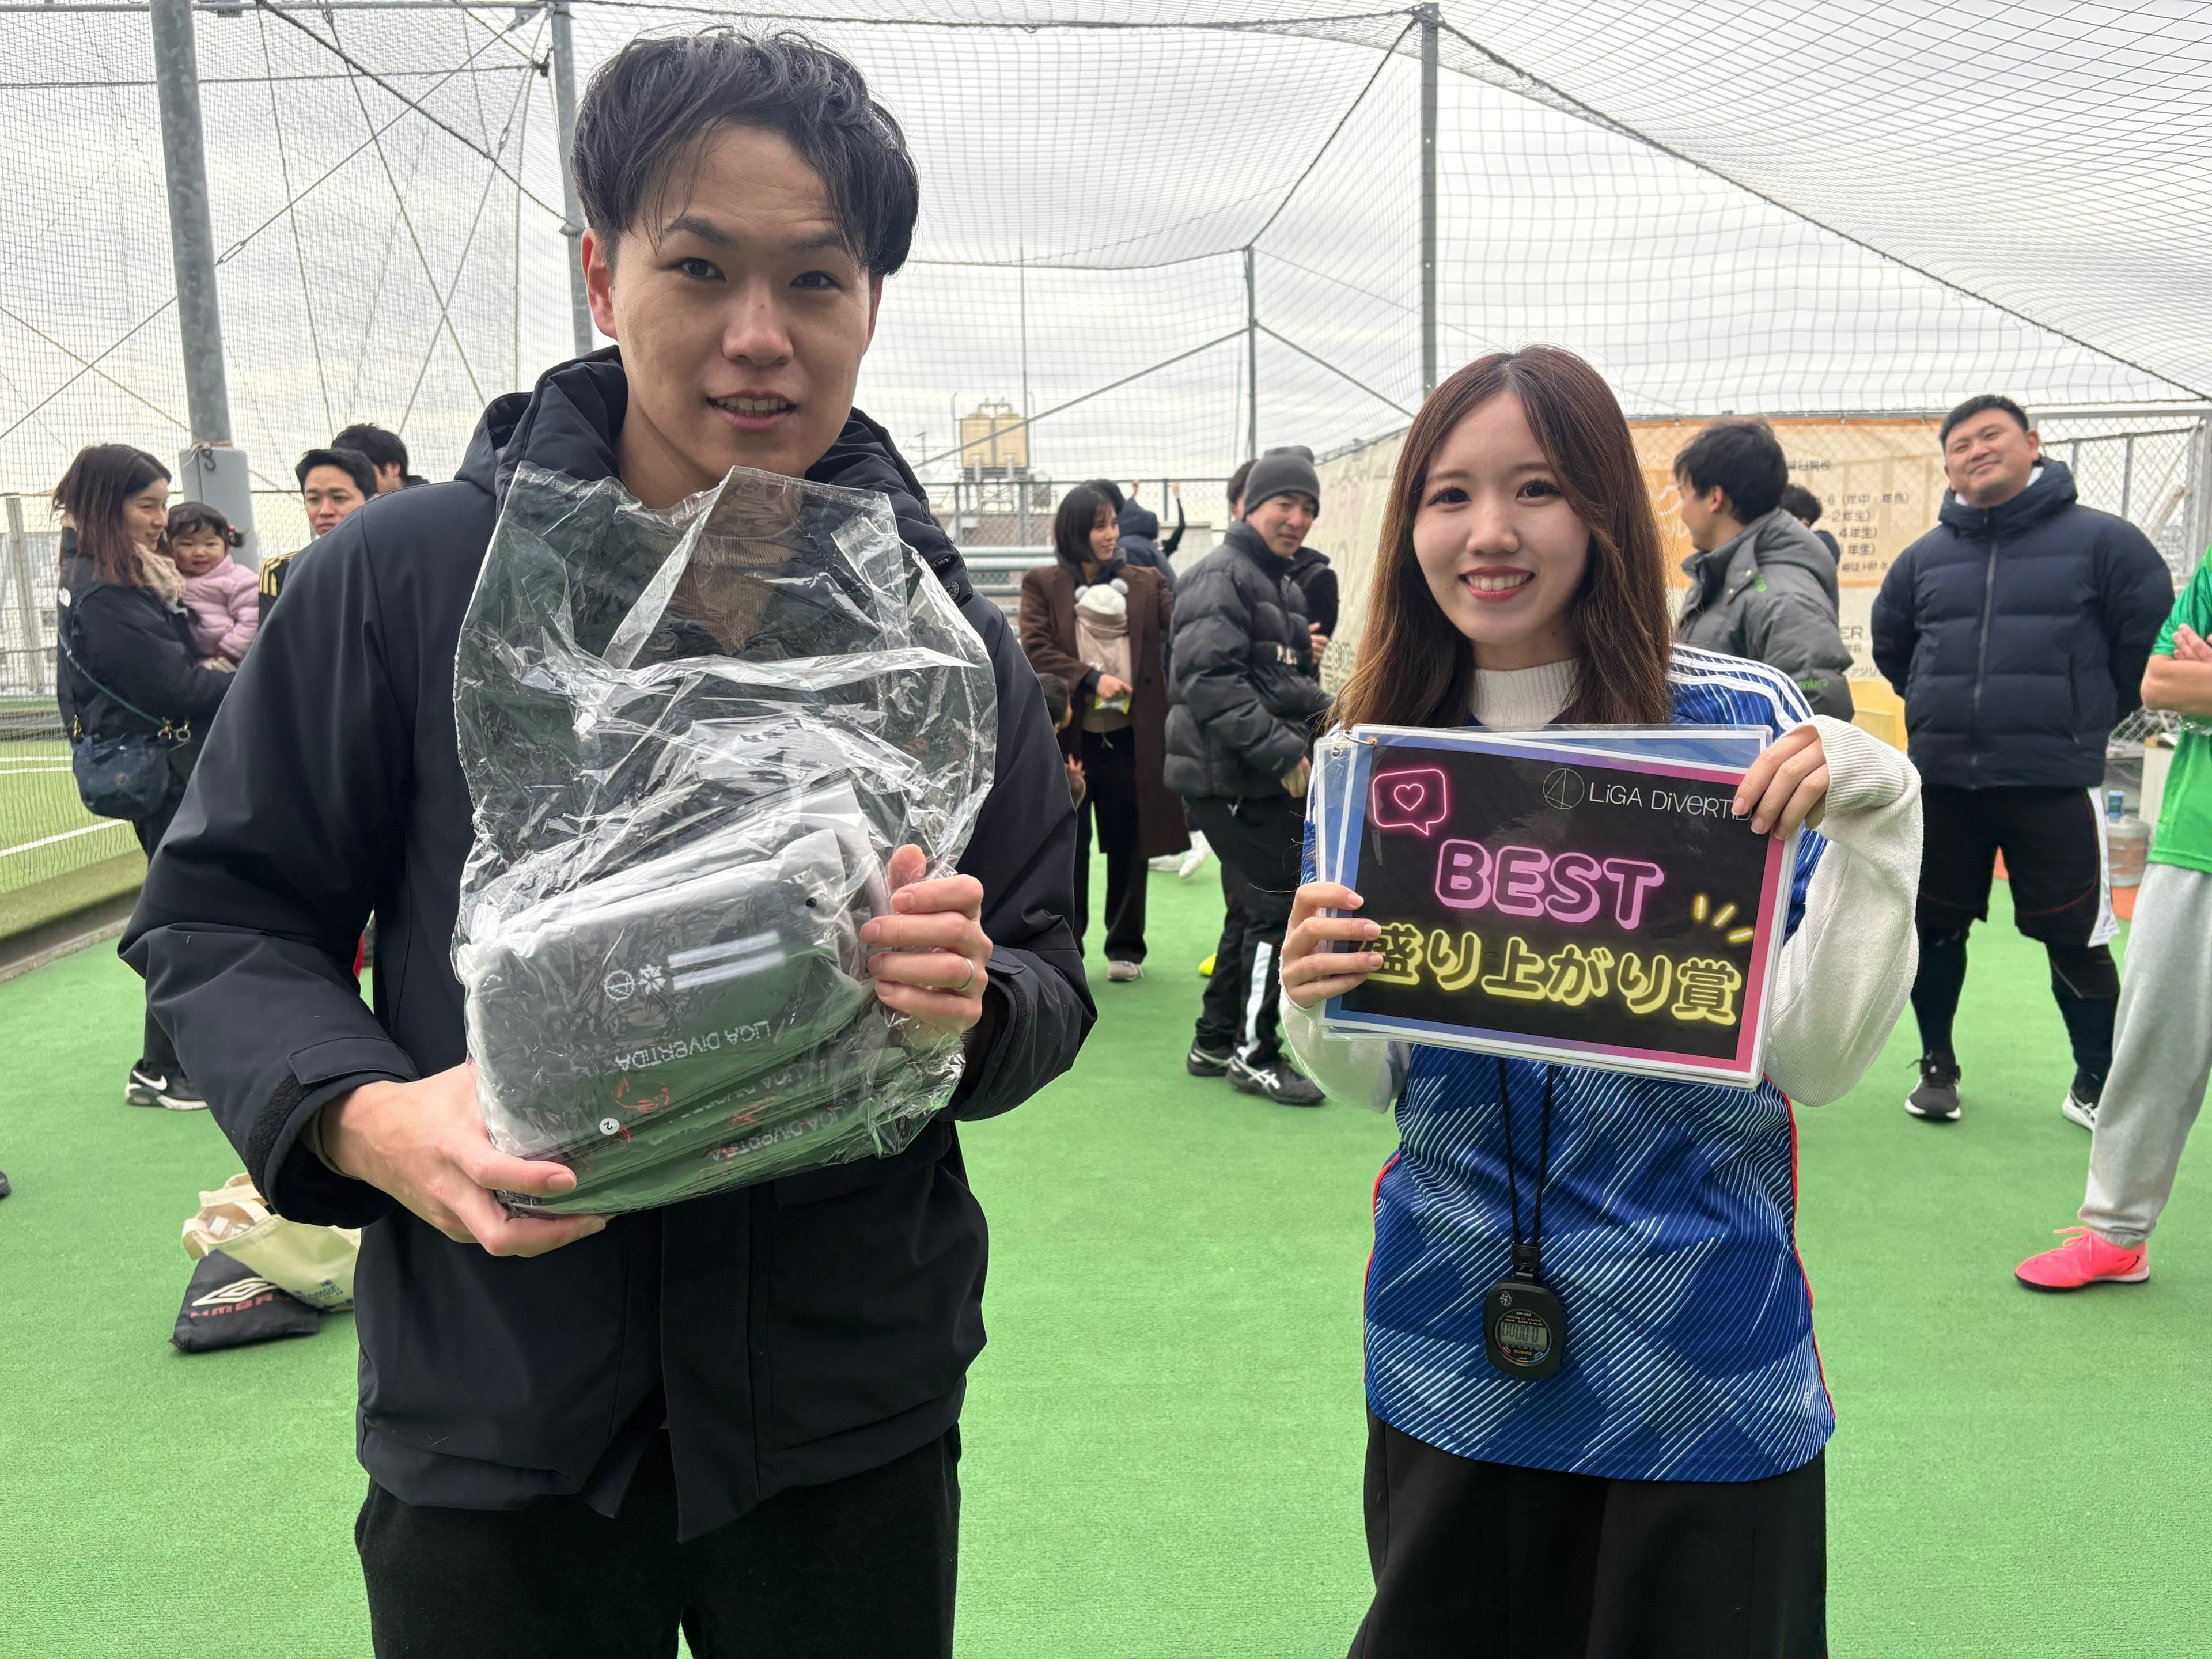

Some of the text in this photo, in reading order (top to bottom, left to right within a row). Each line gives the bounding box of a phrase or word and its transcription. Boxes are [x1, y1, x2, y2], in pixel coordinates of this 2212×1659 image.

[1435, 839, 1665, 930] BEST
[1367, 922, 1741, 1026] 盛り上がり賞
